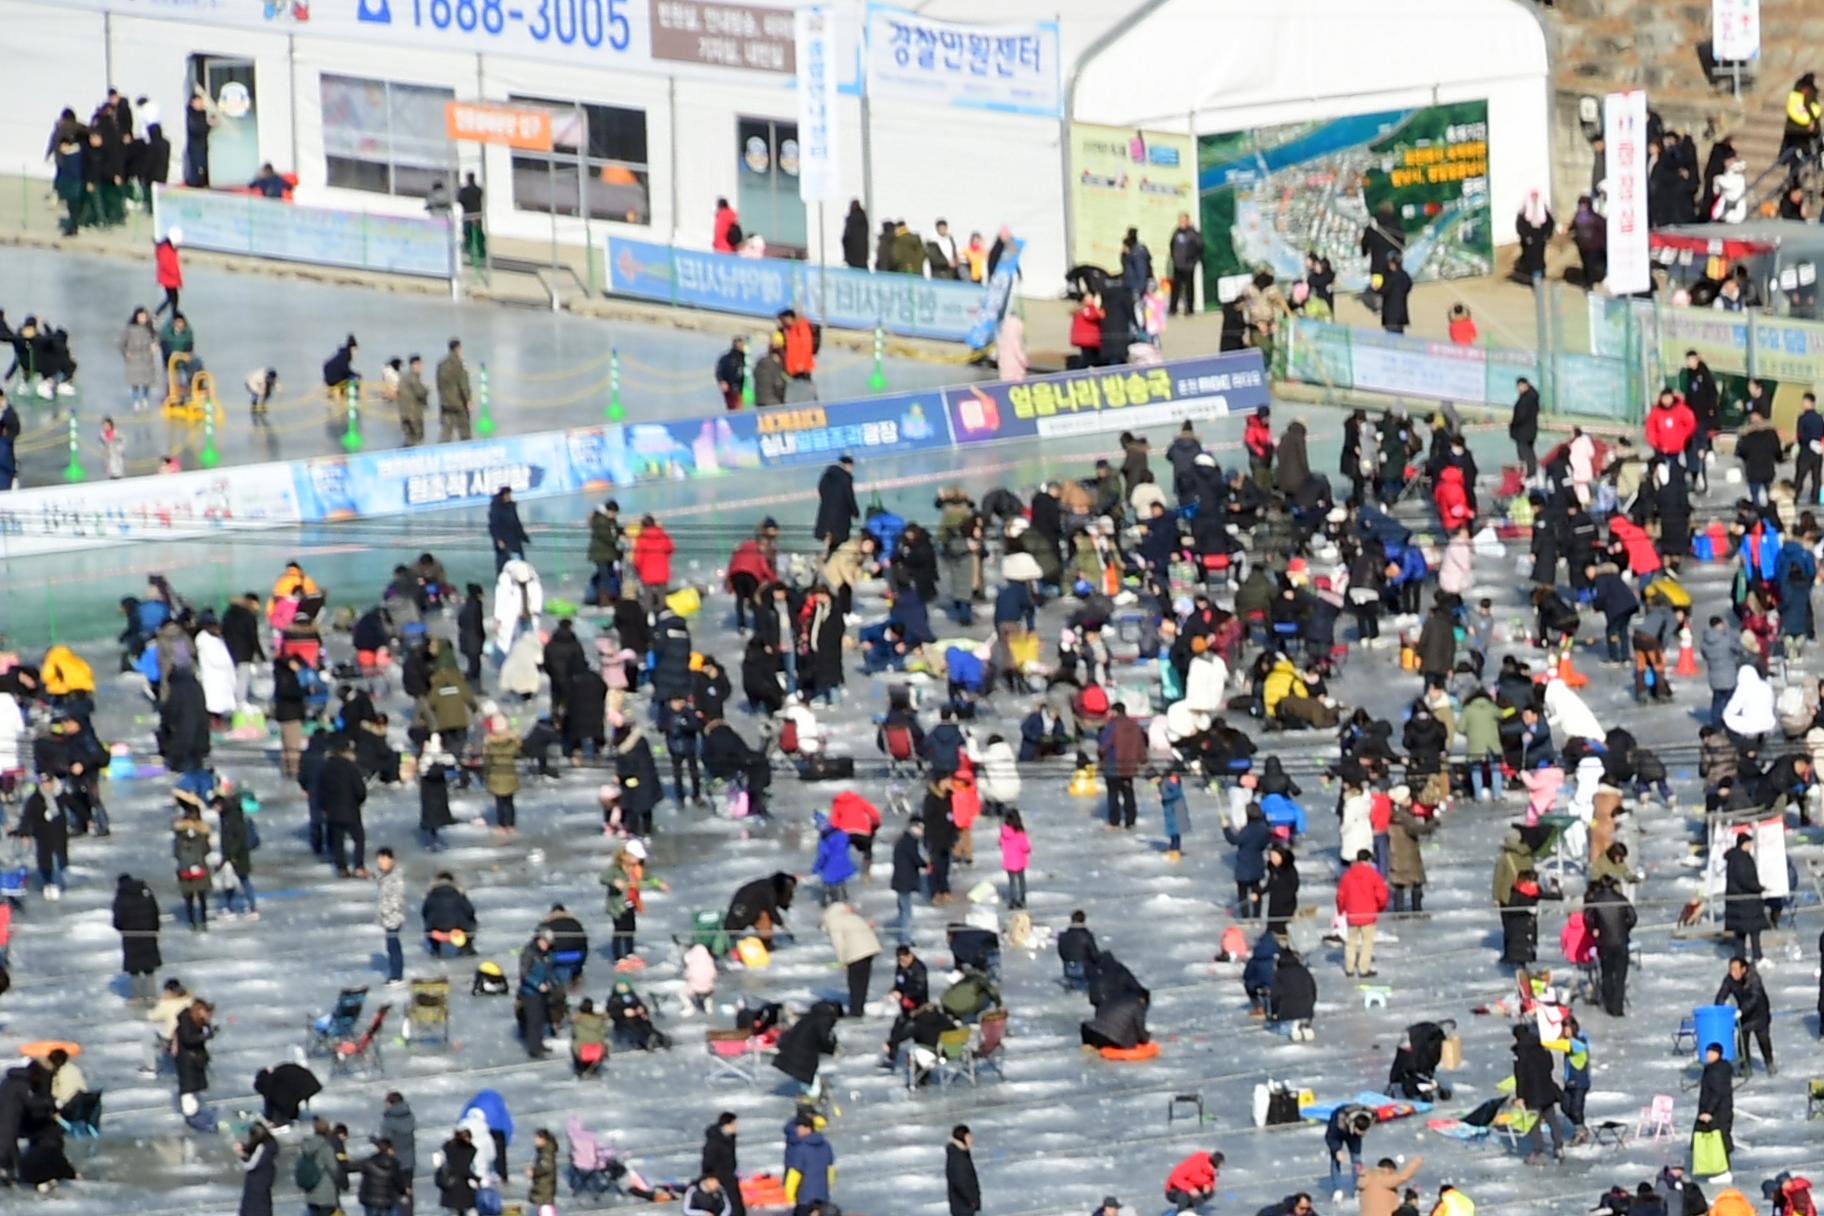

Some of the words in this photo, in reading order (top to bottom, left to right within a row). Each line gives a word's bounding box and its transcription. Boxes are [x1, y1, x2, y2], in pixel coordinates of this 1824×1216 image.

[411, 0, 631, 51] 1688-3005
[888, 19, 1042, 78] 경찰민원센터
[1008, 377, 1101, 420] 얼음나라
[1102, 367, 1172, 409] 방송국
